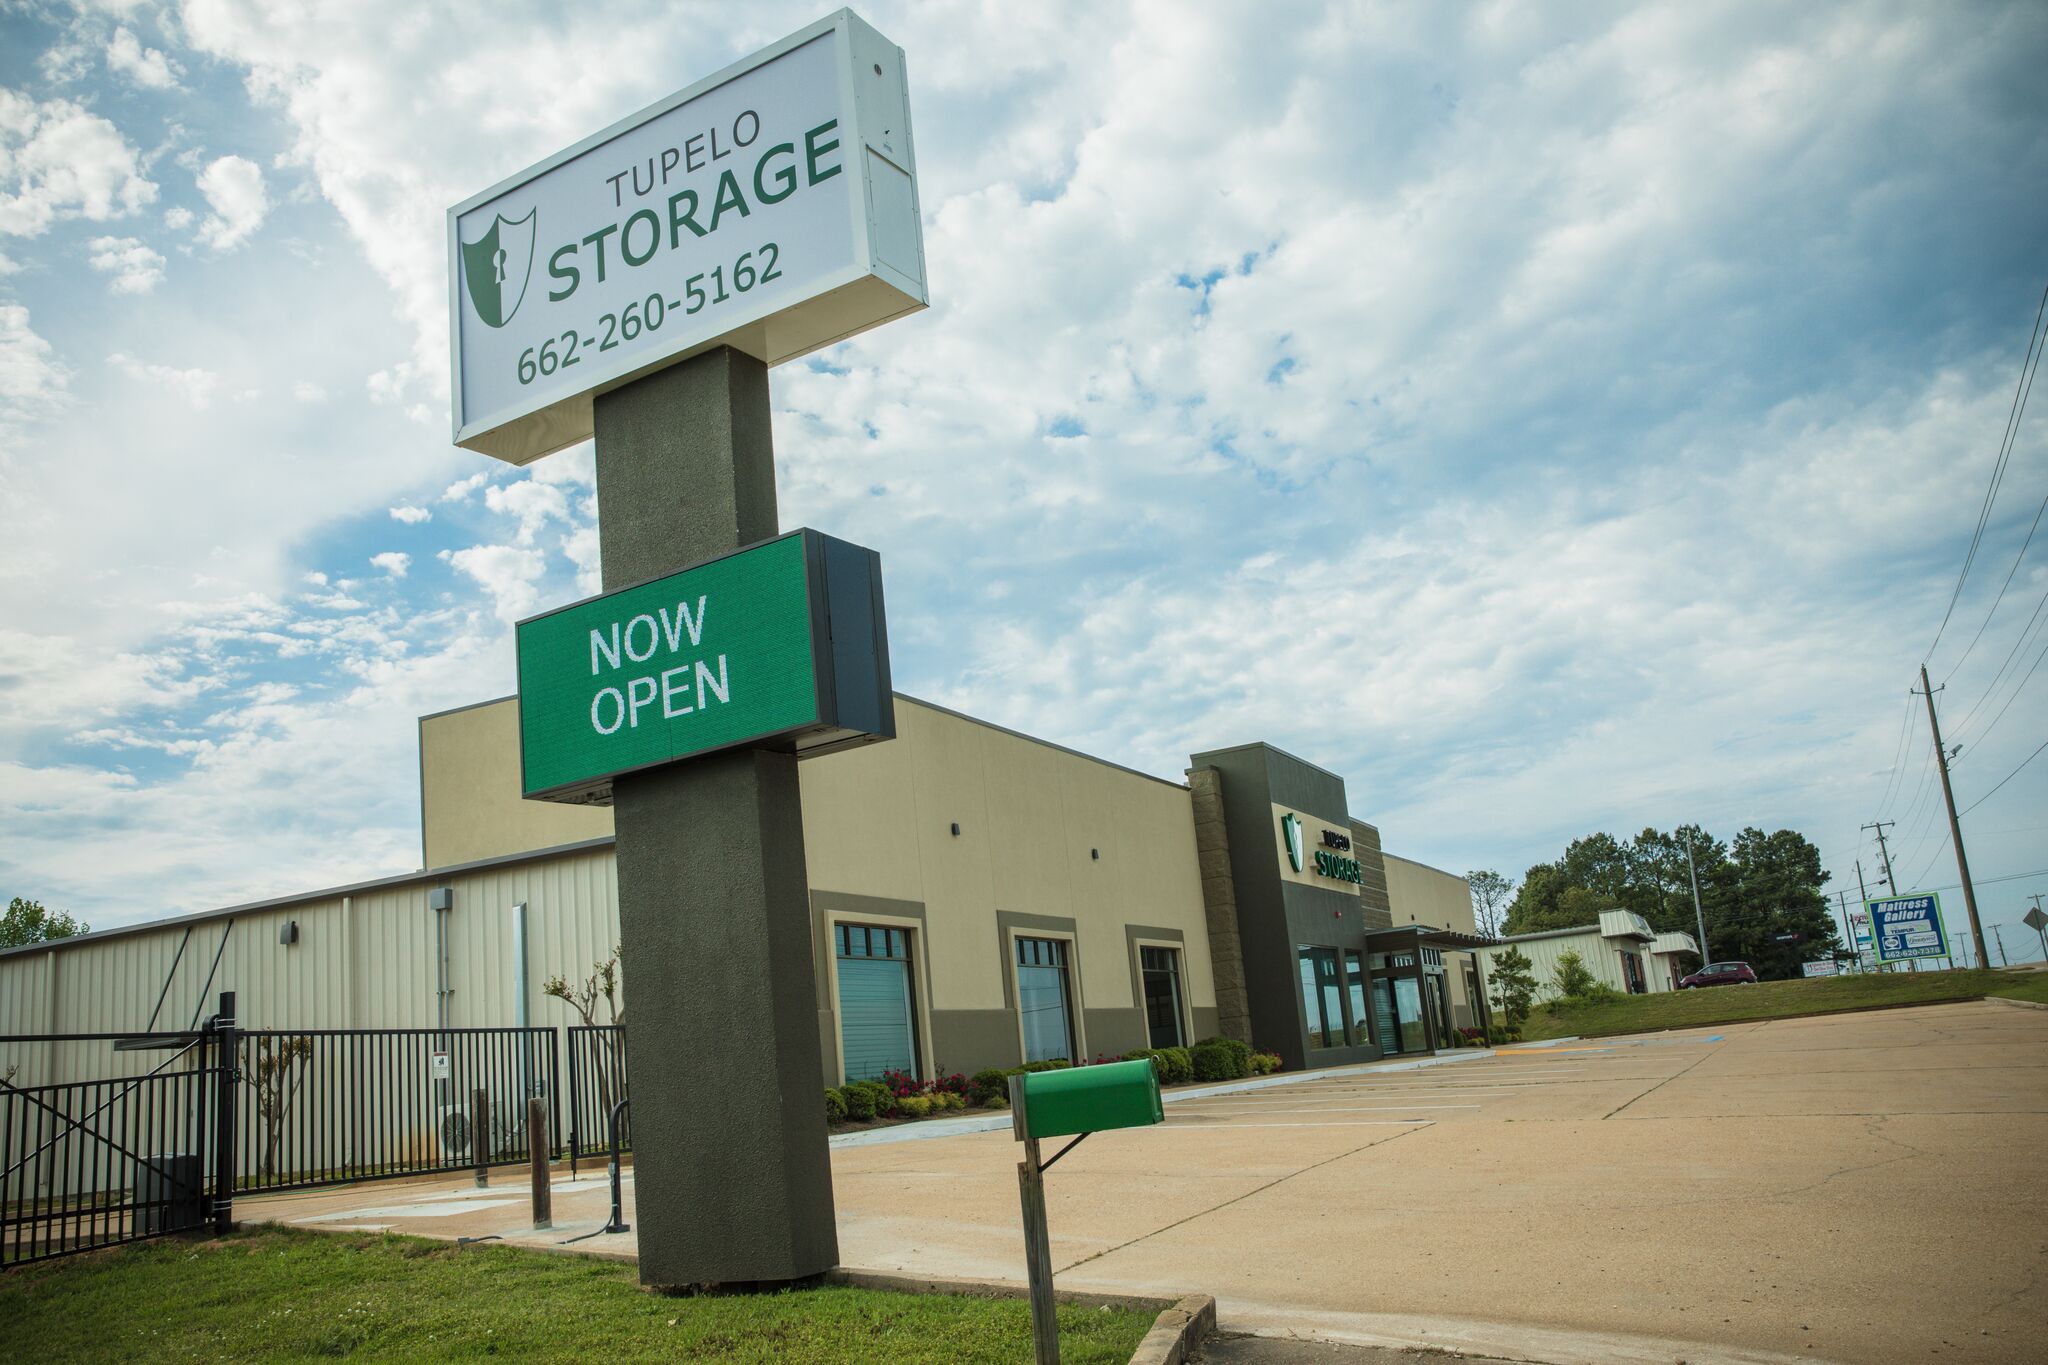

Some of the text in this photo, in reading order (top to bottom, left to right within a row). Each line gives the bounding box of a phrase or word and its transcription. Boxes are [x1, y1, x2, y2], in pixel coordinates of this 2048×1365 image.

[606, 110, 760, 207] TUPELO
[548, 118, 842, 302] STORAGE
[517, 243, 782, 385] 662-260-5162
[590, 595, 707, 675] NOW
[591, 654, 730, 735] OPEN
[1315, 850, 1364, 884] STORAGE
[1877, 899, 1928, 913] Mattress
[1884, 909, 1926, 922] Gallery
